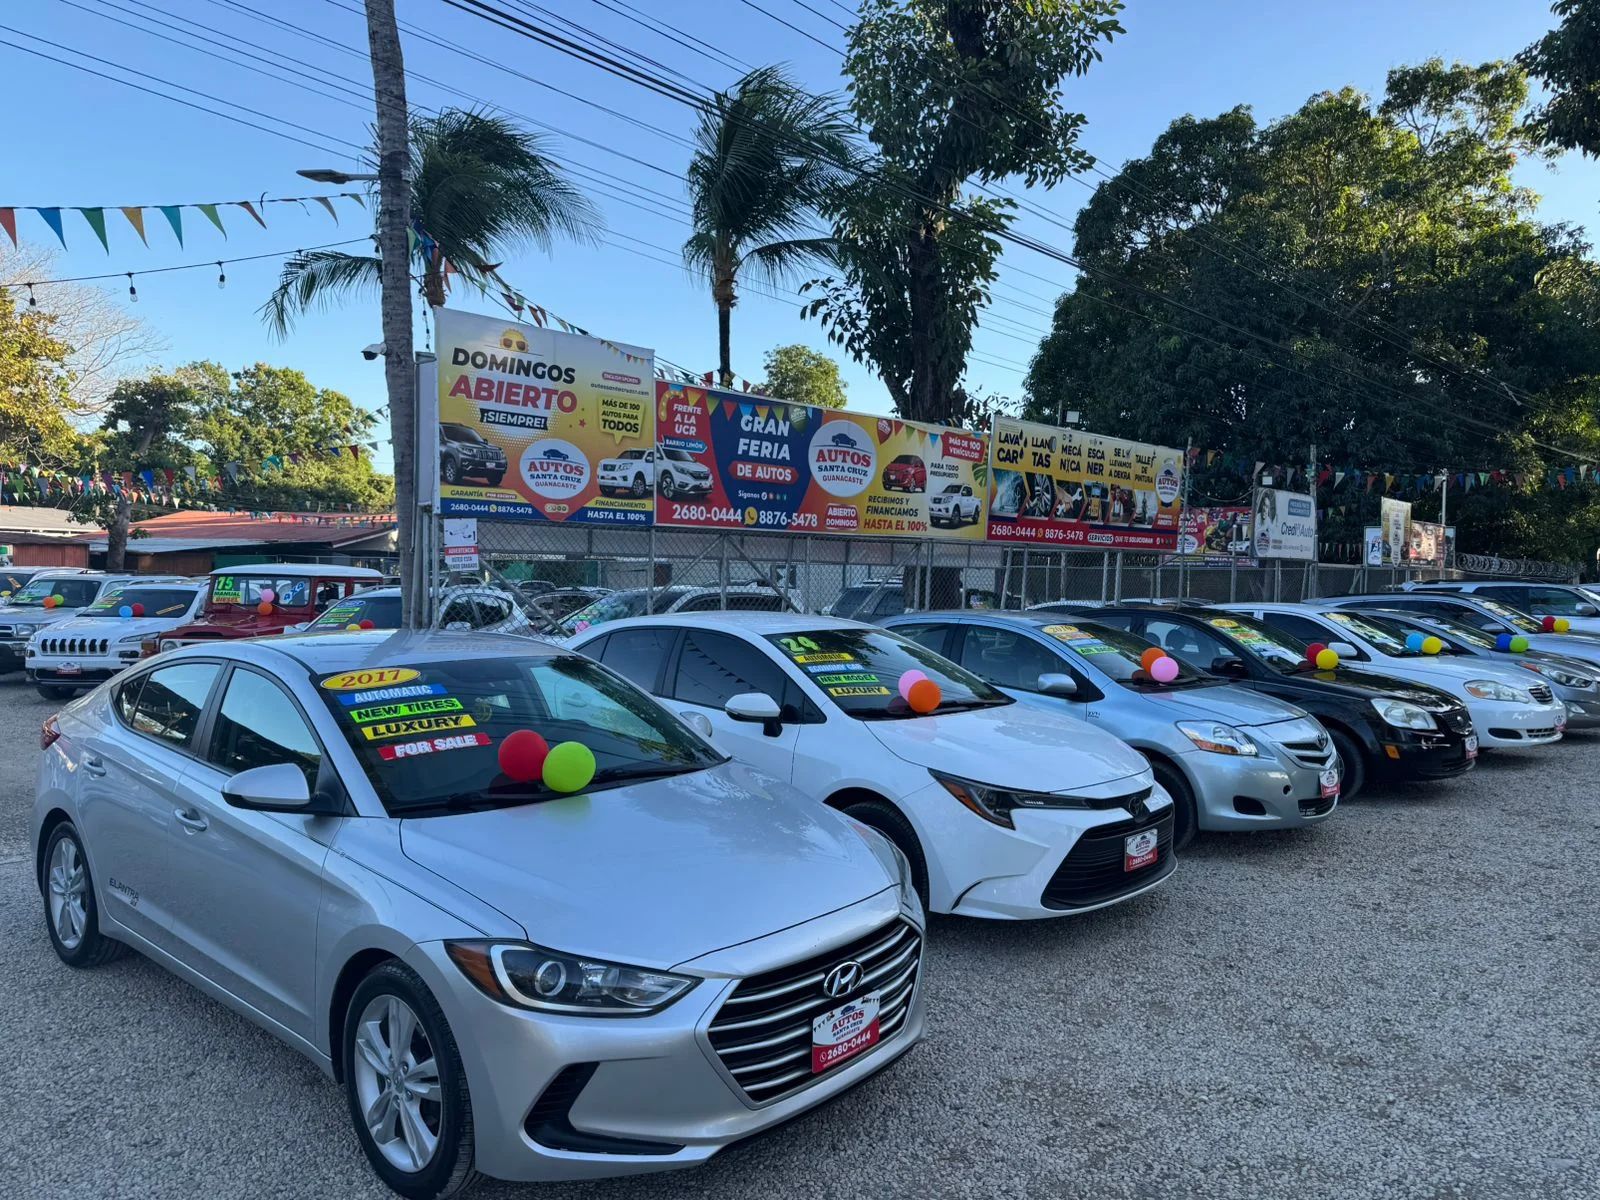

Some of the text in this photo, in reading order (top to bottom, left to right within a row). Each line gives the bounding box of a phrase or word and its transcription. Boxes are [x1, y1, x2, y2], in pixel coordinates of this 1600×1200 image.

[452, 347, 576, 385] DOMINGOS
[448, 374, 578, 414] ABIERTO
[602, 399, 618, 408] MÁS
[673, 404, 702, 414] FRENTE
[483, 411, 545, 428] ¡SIEMPRE!
[602, 410, 622, 418] AUTOS
[674, 414, 696, 424] A LA
[602, 418, 640, 433] TODOS
[674, 424, 697, 436] UCR
[740, 415, 790, 437] GRAN
[998, 432, 1020, 446] LAVA
[1032, 437, 1050, 450] LLAN
[737, 438, 790, 460] FERIA
[970, 441, 981, 450] 100
[1061, 444, 1082, 457] MECÁ
[816, 449, 872, 468] AUTOS
[997, 448, 1018, 464] CAR
[1088, 448, 1105, 460] ESCA
[1114, 448, 1121, 457] SE
[930, 462, 944, 470] PARA
[1032, 452, 1051, 468] TAS
[1060, 458, 1081, 473] NICA
[1109, 459, 1132, 469] LLEVAMOS
[528, 461, 584, 476] AUTOS
[736, 464, 792, 482] DE AUTOS
[818, 464, 868, 477] SANTA CRUZ
[930, 470, 959, 479] PRESUPUESTO
[1086, 462, 1104, 476] NER
[1141, 466, 1148, 474] DE
[560, 474, 582, 484] CRUZ
[822, 474, 864, 486] GUANACASTE
[1114, 470, 1131, 480] DEKRA
[1134, 474, 1154, 484] PINTURA
[535, 481, 576, 490] GUANACASTE
[1158, 478, 1179, 488] AUTOS
[738, 490, 760, 498] Síganos
[868, 496, 904, 504] RECIBIMOS
[450, 504, 533, 514] 2680-0444 8876-5478
[595, 500, 646, 509] FINANCIAMIENTO
[587, 510, 614, 520] HASTA
[627, 512, 646, 521] 100%
[672, 504, 818, 527] 2680-0444 8876-5478
[827, 507, 857, 516] ABIERTO
[866, 506, 919, 517] FINANCIAMOS
[826, 518, 858, 527] DOMINGOS
[864, 518, 928, 532] HASTA EL 100%
[991, 524, 1084, 540] 2680-0444 8876-5478
[1088, 534, 1112, 542] SERVICIOS
[780, 636, 820, 653] 24
[341, 670, 400, 688] 2017
[354, 685, 432, 704] AUTOMATIC
[833, 686, 882, 695] LUXURY
[357, 699, 458, 720] NEW TIRES
[372, 716, 462, 737] LUXURY
[394, 734, 478, 758] FOR SALE
[110, 878, 139, 900] ELANTRA
[832, 1010, 865, 1033] AUTOS
[832, 1026, 850, 1037] SANTA
[827, 1030, 872, 1060] 2680-0444
